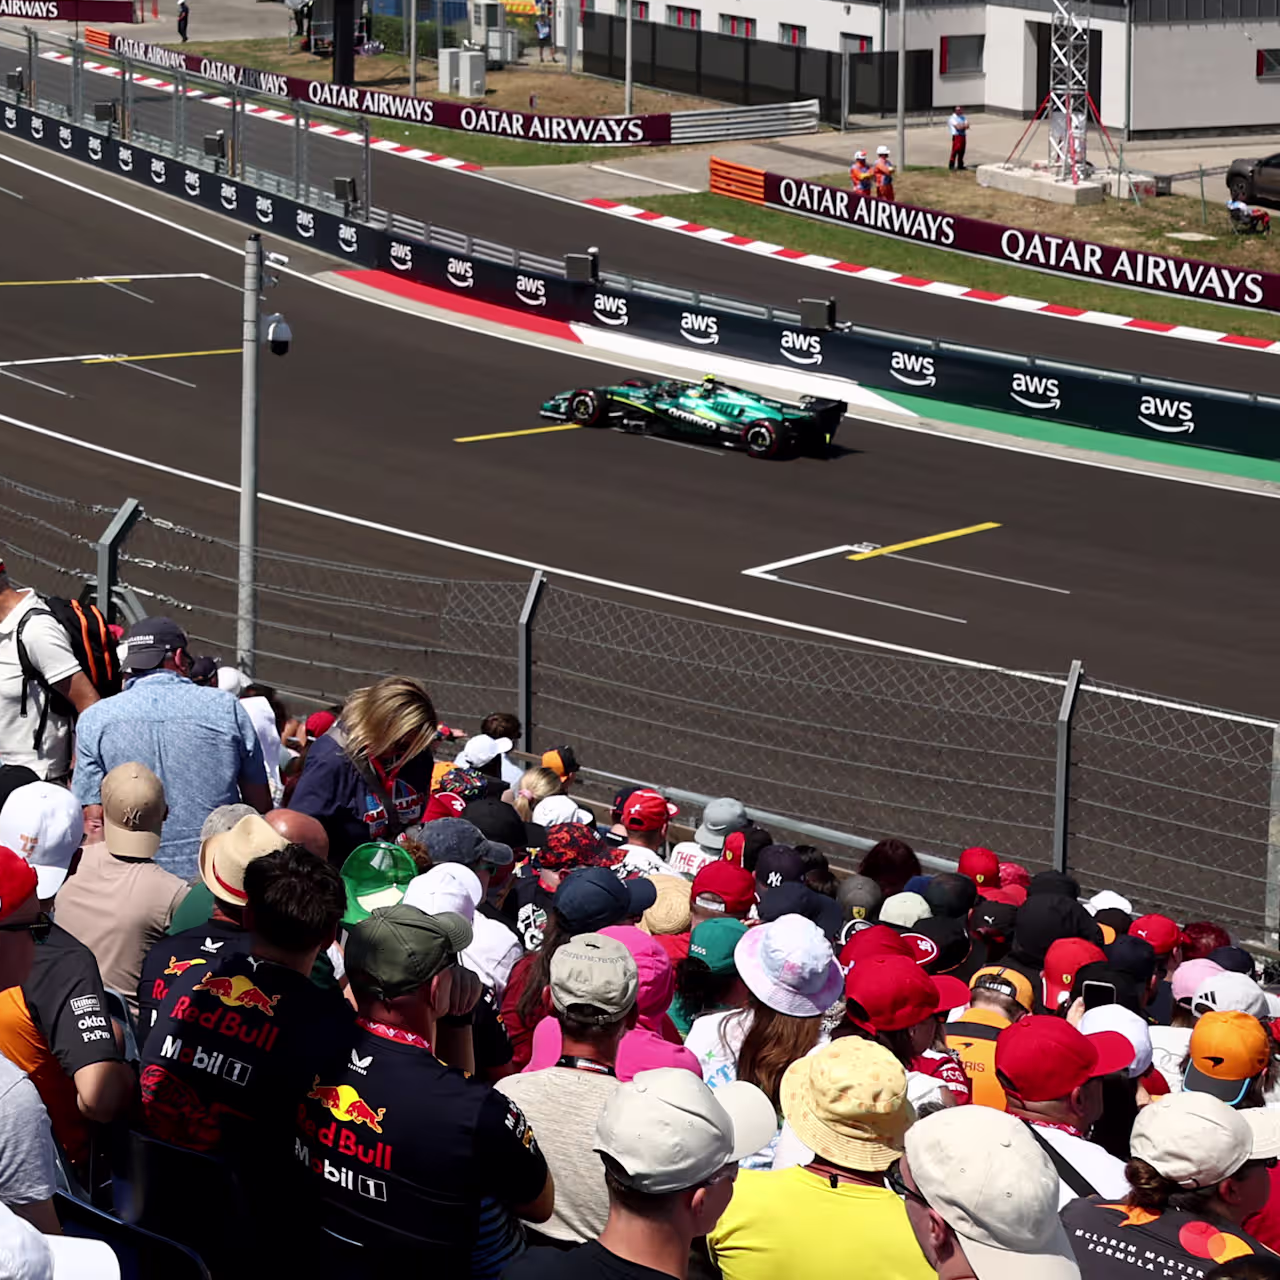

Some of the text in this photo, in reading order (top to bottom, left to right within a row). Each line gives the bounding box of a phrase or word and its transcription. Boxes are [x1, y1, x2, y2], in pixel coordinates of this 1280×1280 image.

[115, 36, 186, 70] QATAR AIRWAYS
[201, 59, 288, 97] QATAR AIRWAYS
[308, 81, 434, 122] QATAR AIRWAYS
[460, 107, 644, 141] QATAR AIRWAYS
[296, 209, 314, 227] aws
[780, 178, 955, 244] QATAR AIRWAYS
[338, 224, 357, 242] aws
[390, 241, 412, 261] aws
[447, 257, 473, 277] aws
[1001, 229, 1264, 304] QATAR AIRWAYS
[516, 275, 545, 296] aws
[594, 294, 627, 315] aws
[681, 312, 718, 333] aws
[781, 330, 821, 353] aws
[890, 351, 935, 375] aws
[1012, 373, 1059, 398] aws
[668, 408, 717, 430] aramco
[1140, 395, 1193, 420] aws
[676, 851, 693, 866] THE
[767, 871, 783, 887] NY
[74, 997, 99, 1009] Hilton
[78, 1015, 106, 1029] okta
[170, 995, 280, 1052] Red Bull
[82, 1030, 111, 1042] FxPro
[160, 1035, 224, 1075] Mobil
[339, 1126, 394, 1172] Bull
[295, 1136, 354, 1191] Mobil
[1075, 1228, 1205, 1279] McLAREN MASTER
[1088, 1244, 1155, 1273] FORMULA
